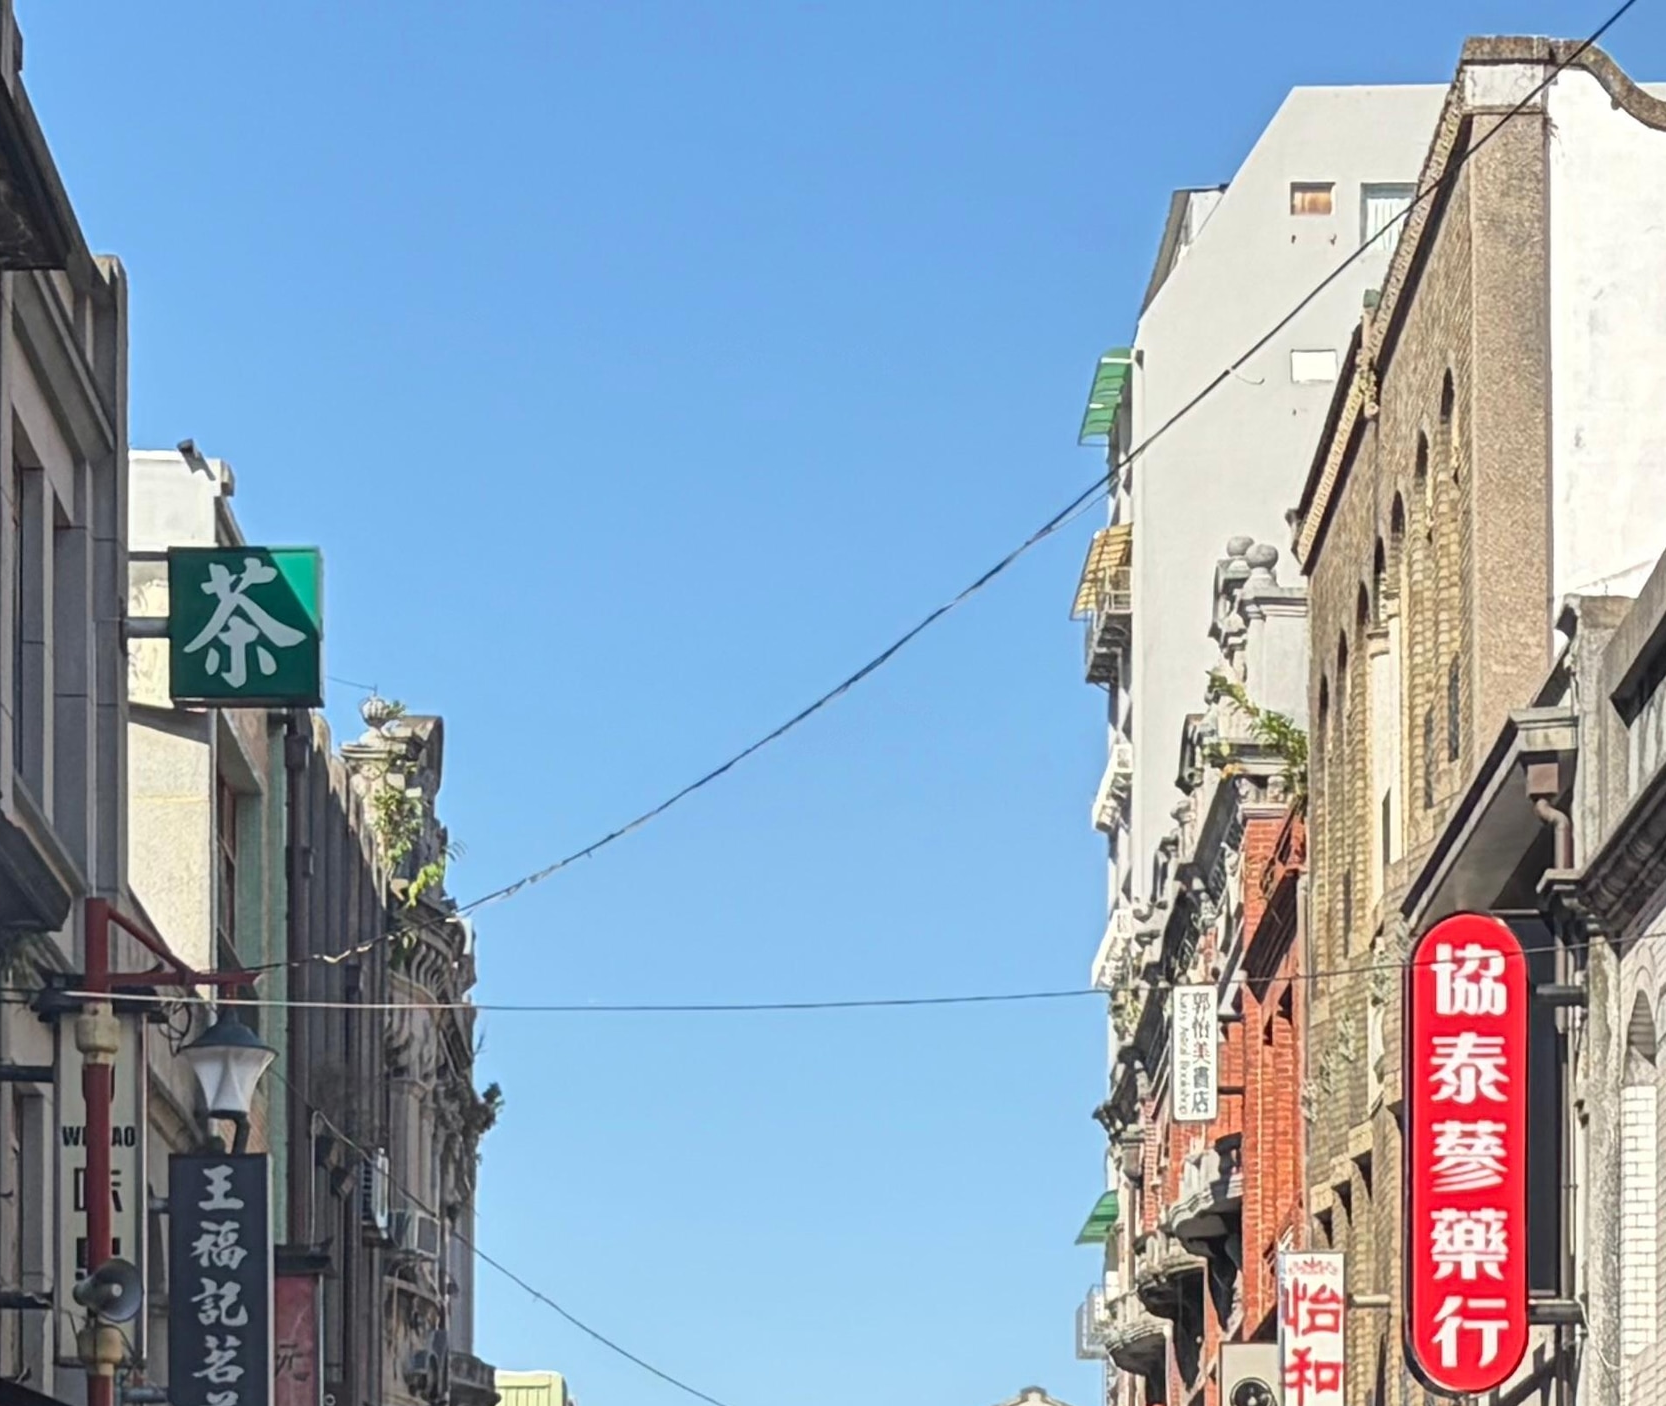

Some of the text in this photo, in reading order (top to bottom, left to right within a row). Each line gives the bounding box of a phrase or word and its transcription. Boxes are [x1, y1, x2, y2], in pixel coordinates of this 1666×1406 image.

[183, 556, 307, 689] 茶
[1430, 943, 1510, 1370] 協泰蔘藥行
